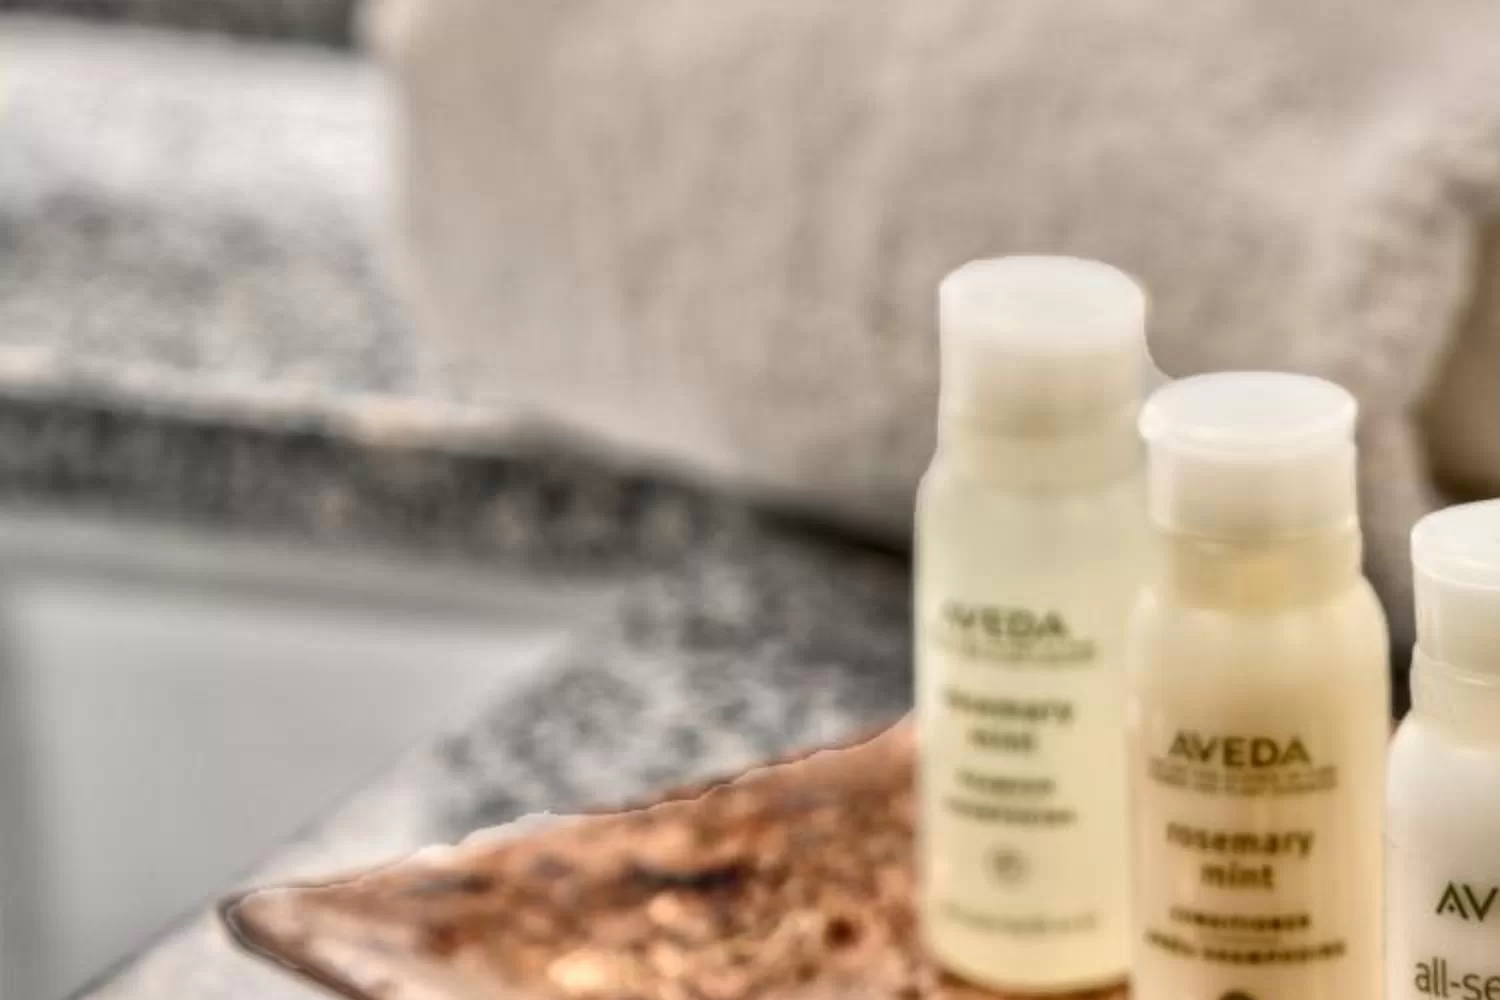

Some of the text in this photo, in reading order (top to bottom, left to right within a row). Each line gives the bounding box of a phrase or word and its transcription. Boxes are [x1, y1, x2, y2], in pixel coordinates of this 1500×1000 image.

[1168, 730, 1311, 768] AVEDA
[1167, 823, 1314, 858] rosemary
[1202, 862, 1275, 889] mint
